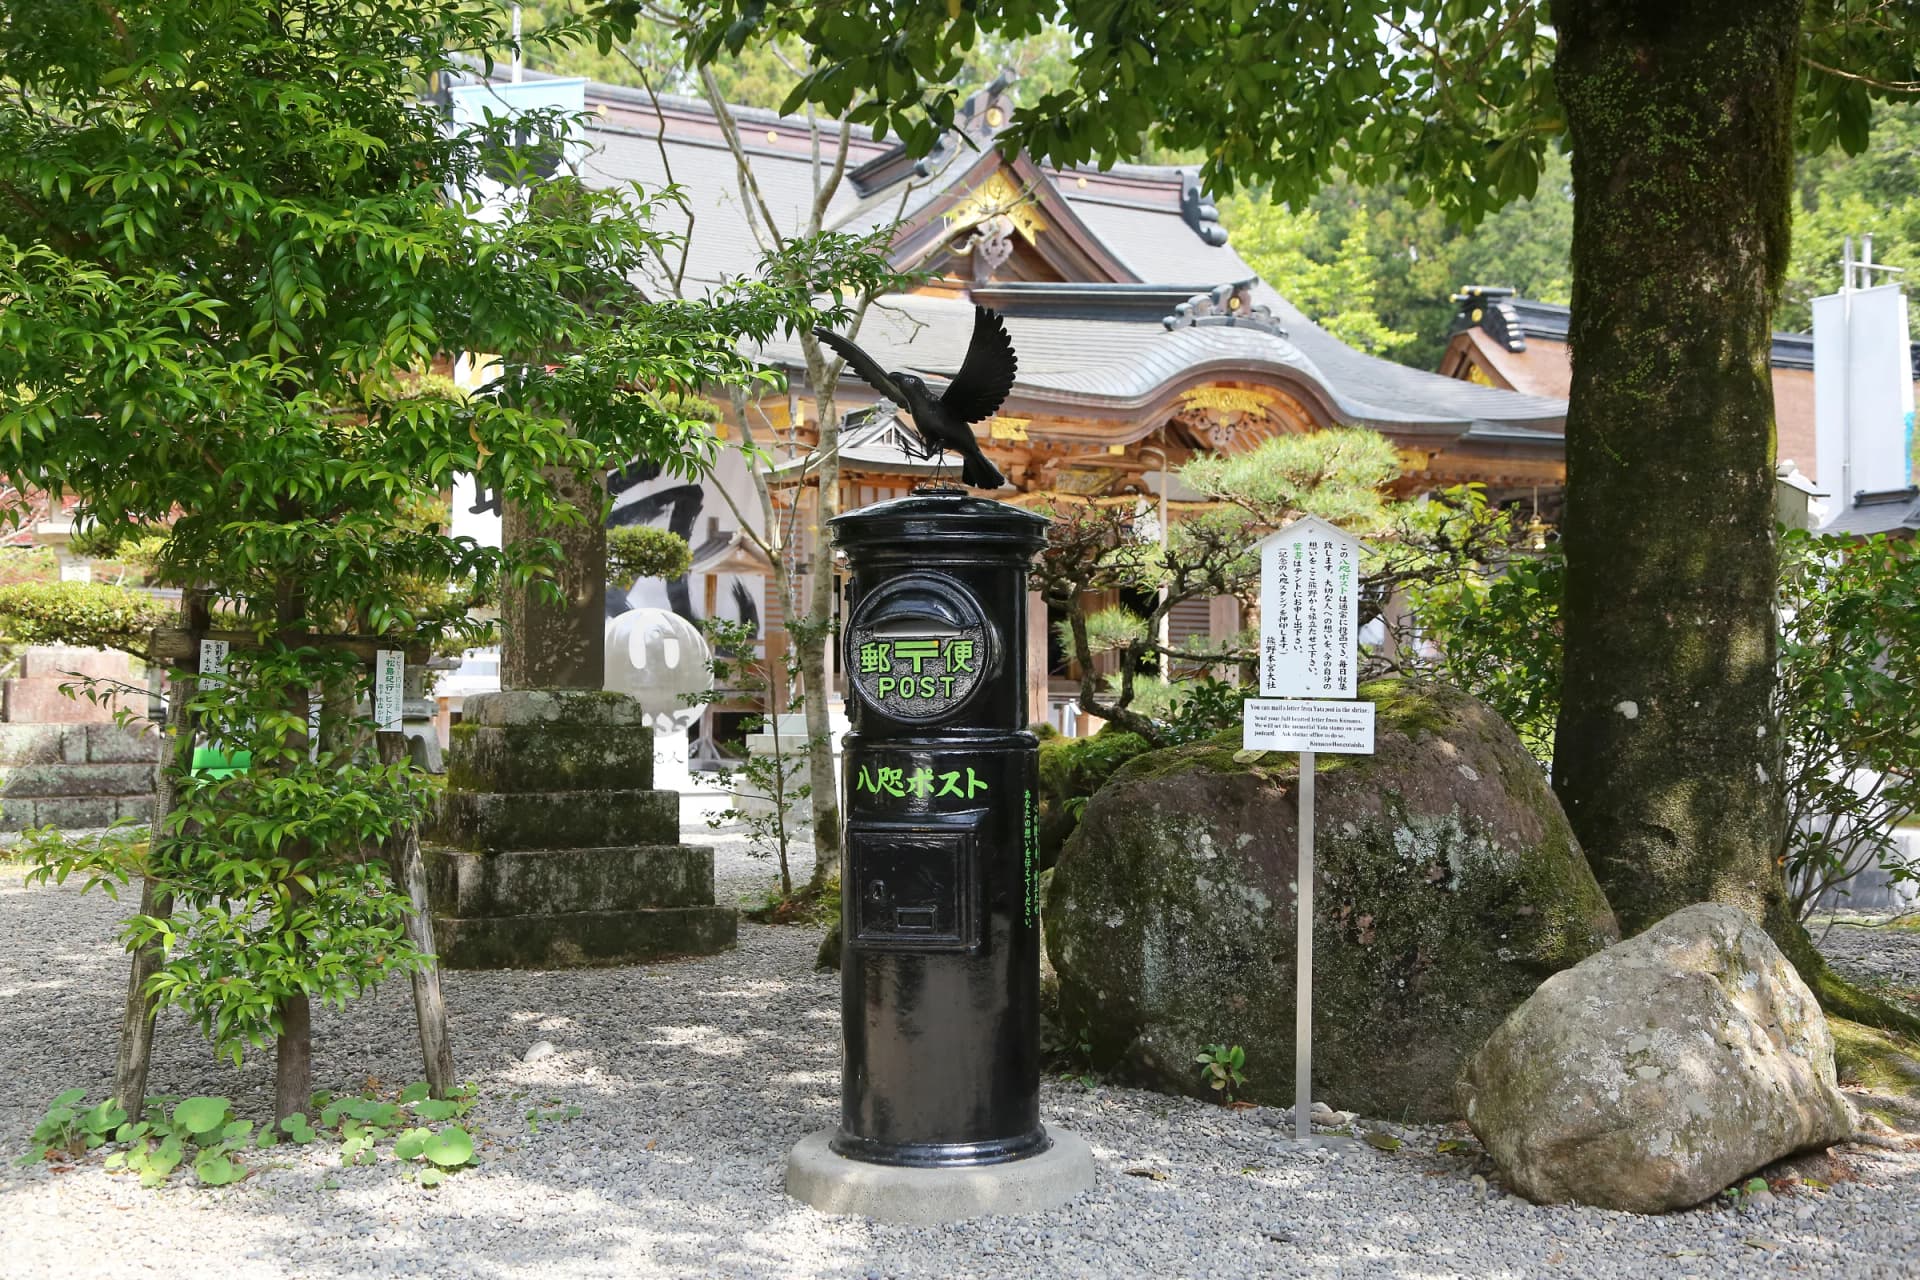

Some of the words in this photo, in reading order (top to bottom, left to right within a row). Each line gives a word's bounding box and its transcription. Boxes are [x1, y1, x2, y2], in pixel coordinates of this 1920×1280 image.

[877, 676, 956, 699] POST
[855, 764, 989, 799] 八咫ポスト
